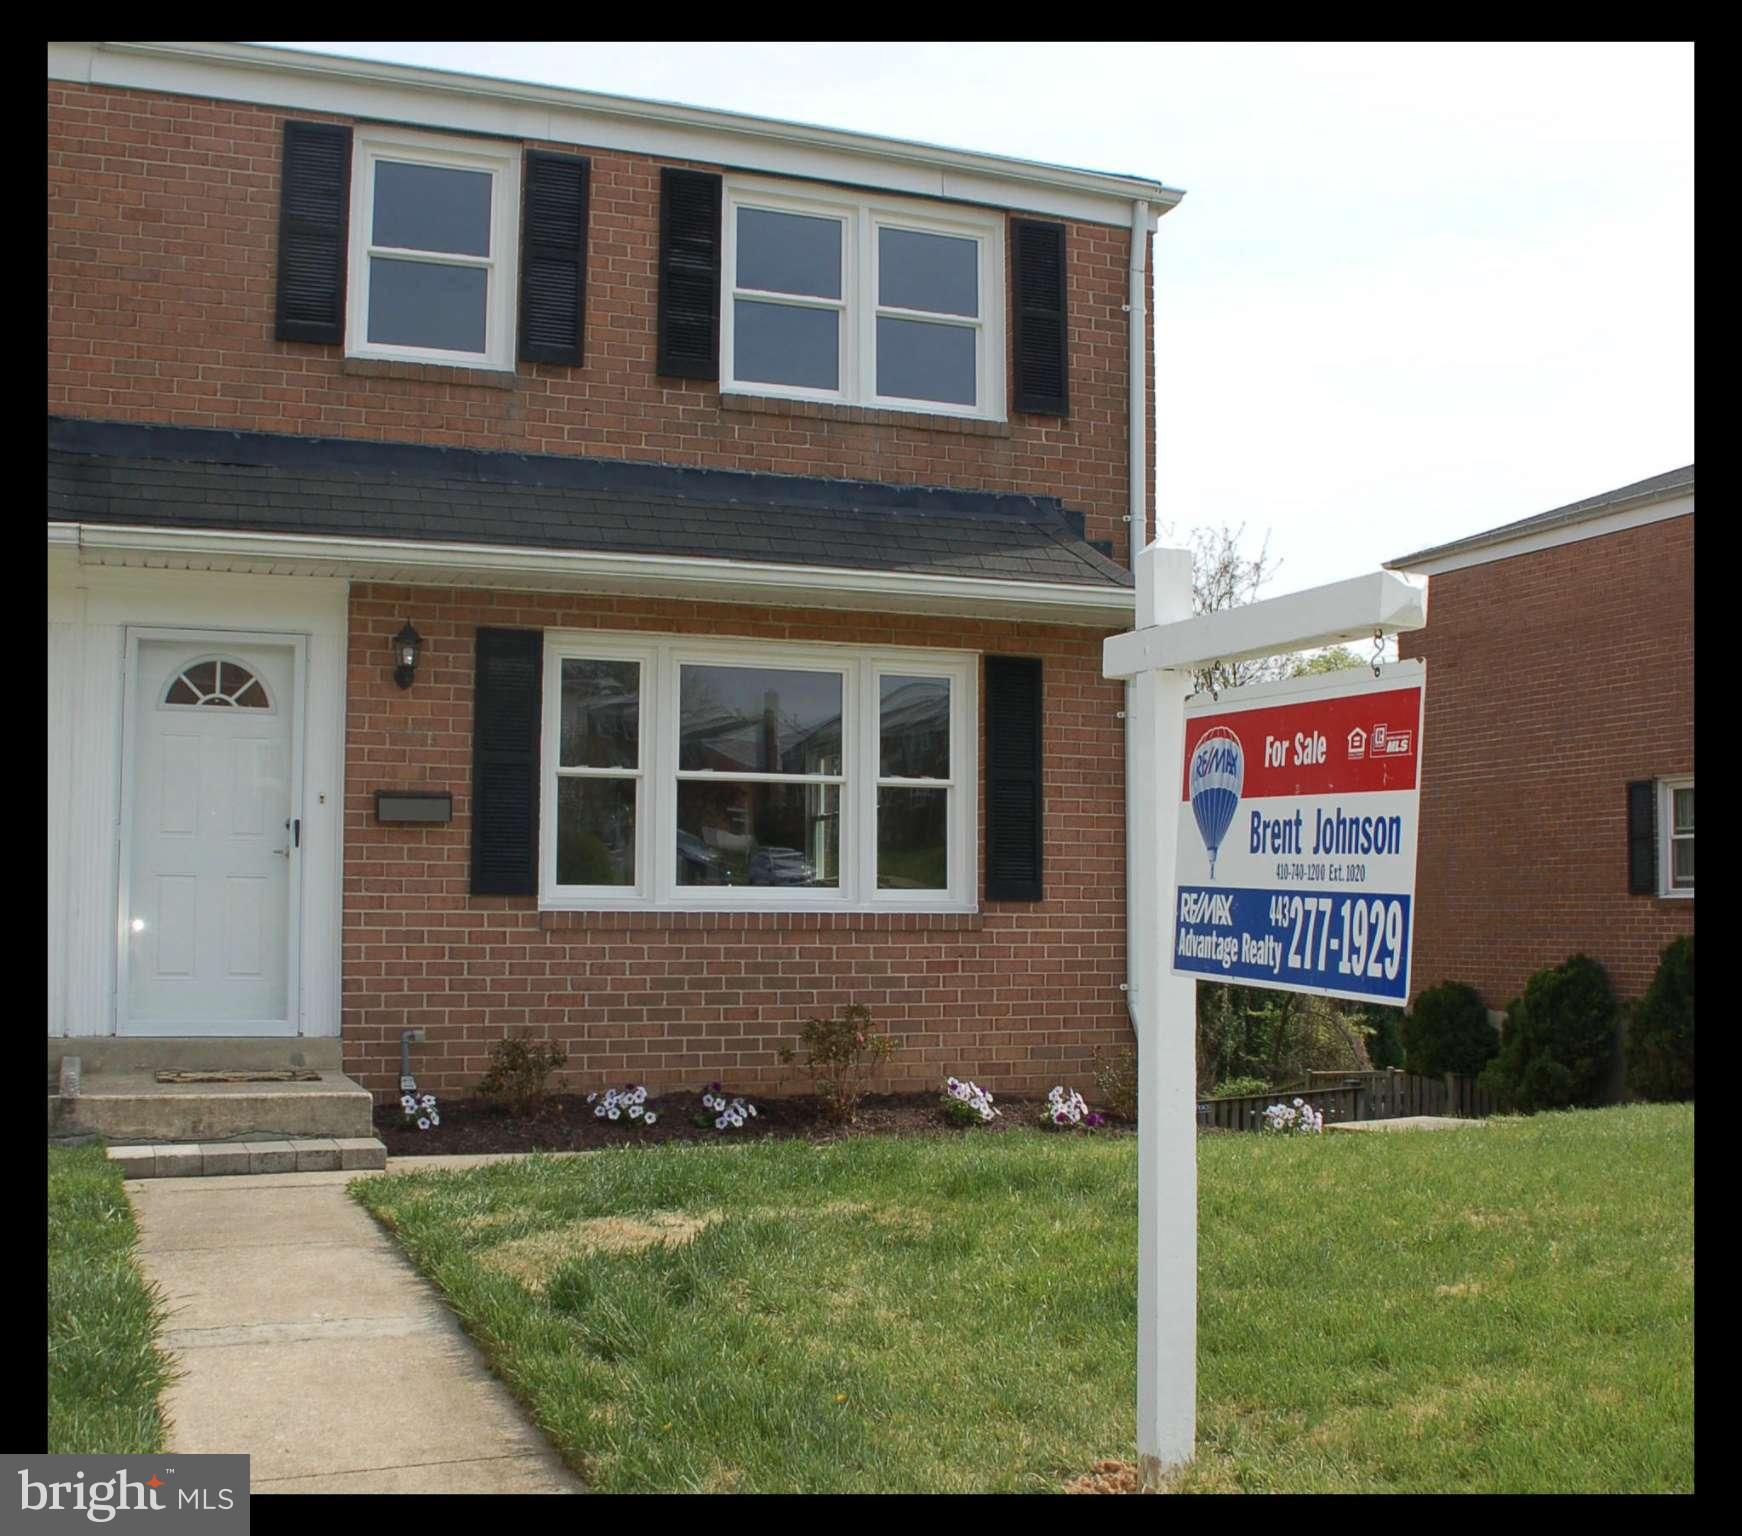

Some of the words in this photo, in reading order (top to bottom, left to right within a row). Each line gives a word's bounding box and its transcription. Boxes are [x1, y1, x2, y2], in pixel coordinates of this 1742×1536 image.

[1196, 747, 1239, 778] RE/MAX
[1264, 735, 1289, 768] For
[1293, 731, 1327, 766] Sale
[1250, 809, 1303, 855] Brent
[1312, 807, 1401, 855] Johnson
[1276, 863, 1325, 881] 410-740-1200
[1180, 892, 1233, 926] RE/MAX
[1178, 927, 1239, 969] Advantage
[1242, 932, 1282, 975] Realty
[1269, 895, 1289, 928] 443
[1288, 896, 1402, 980] 277-1929
